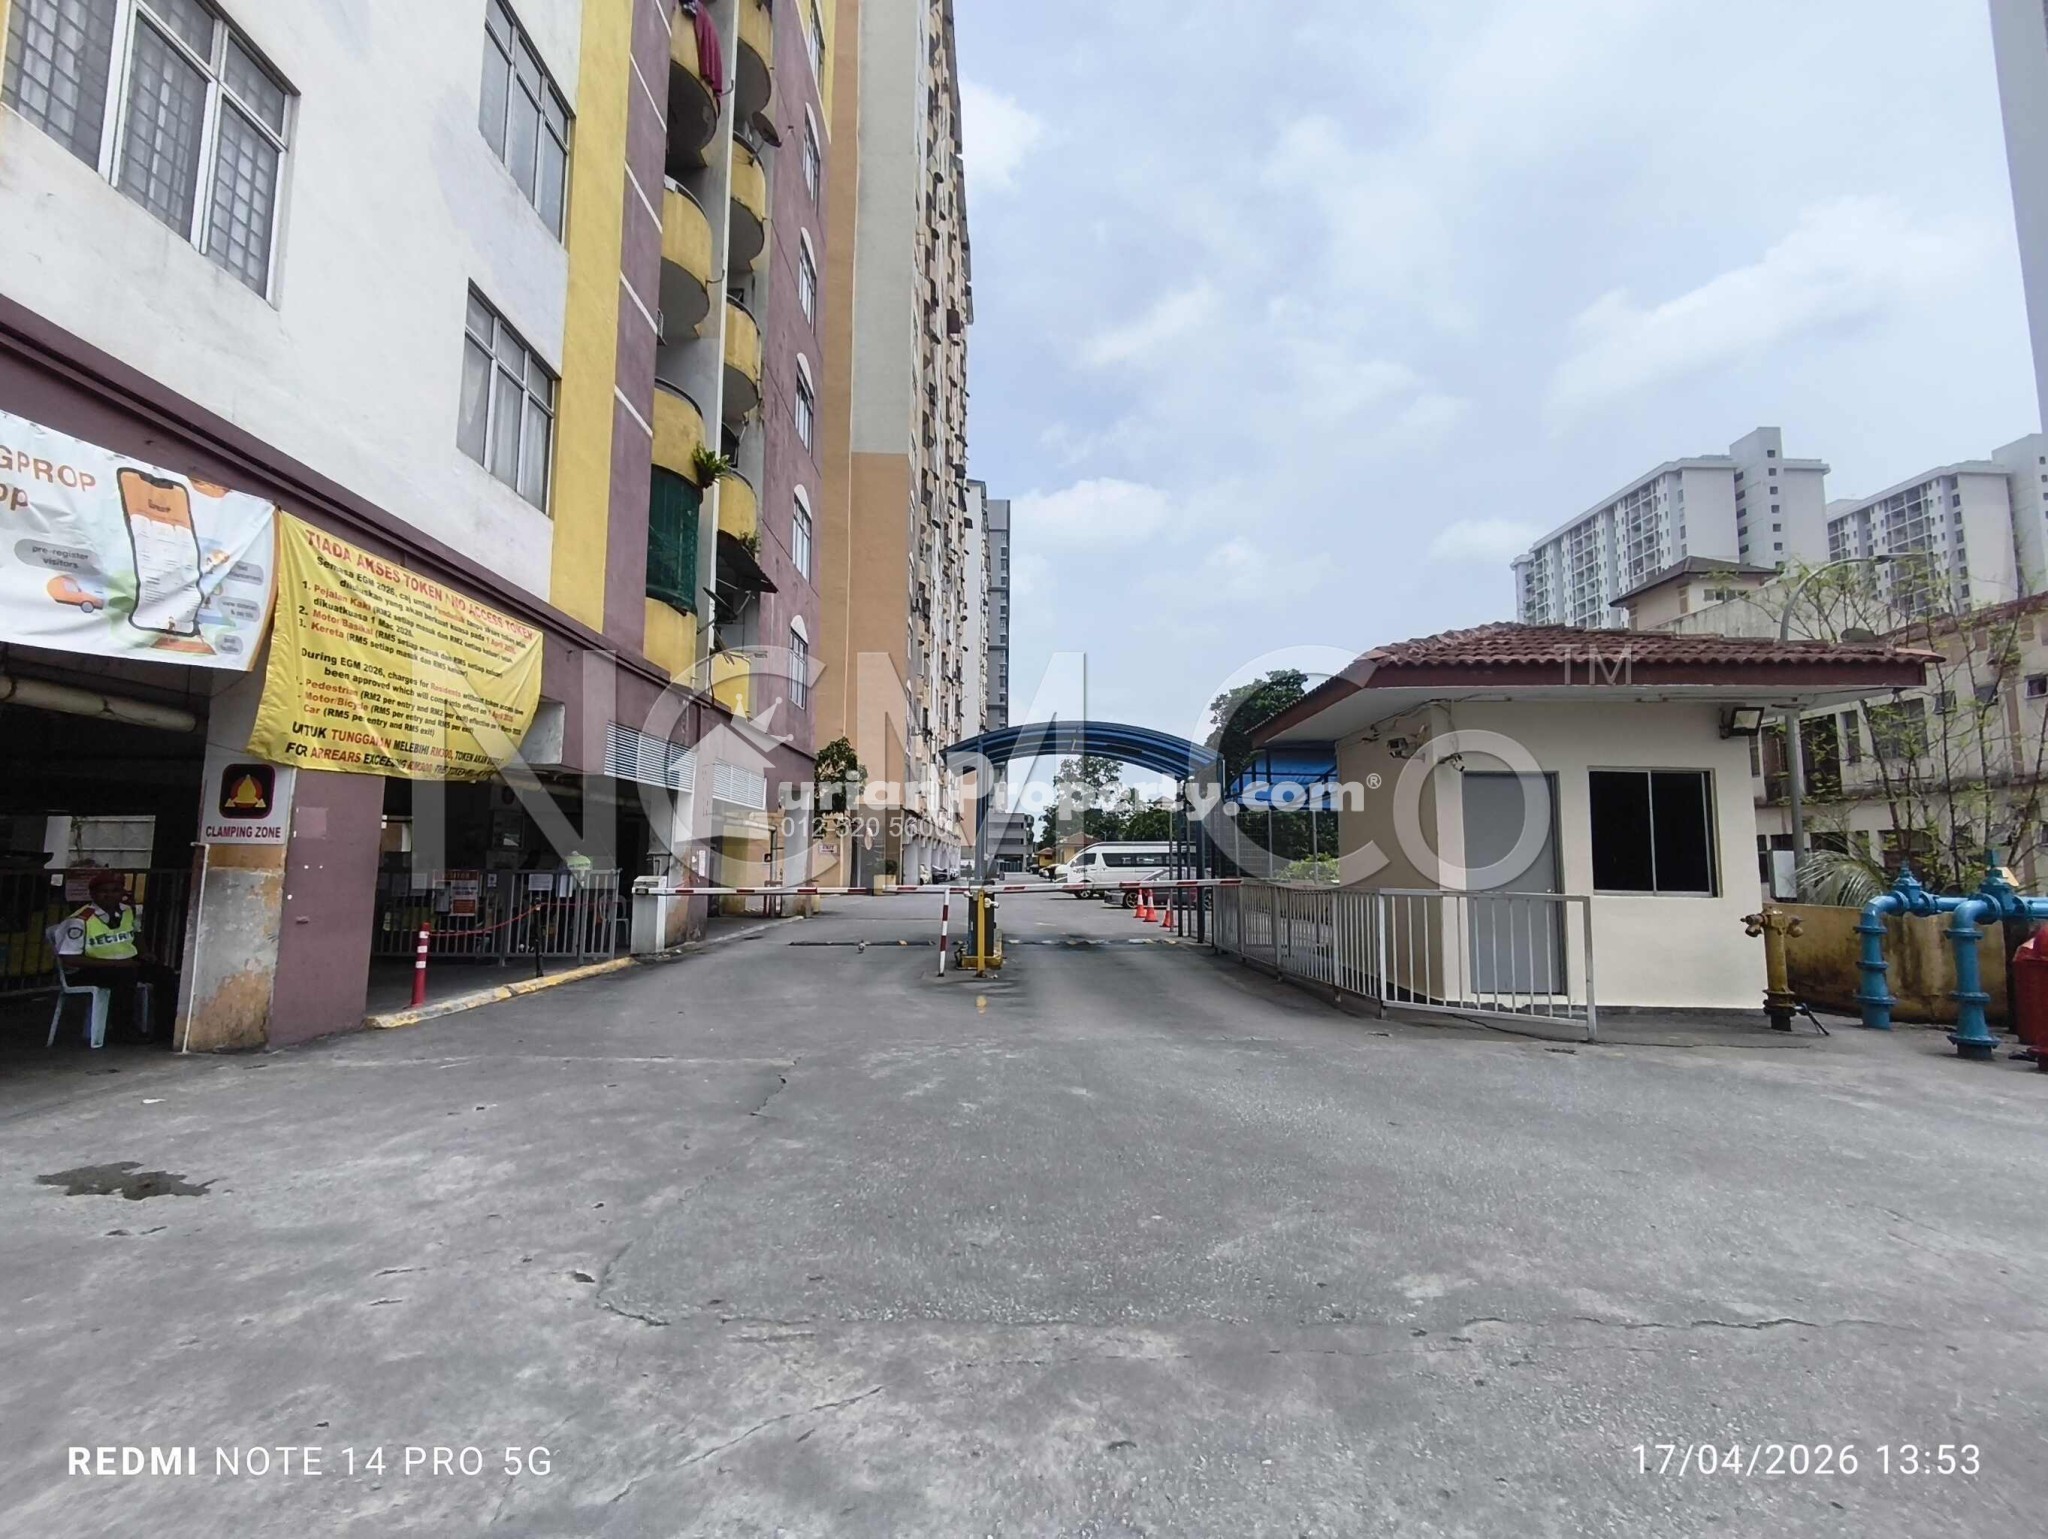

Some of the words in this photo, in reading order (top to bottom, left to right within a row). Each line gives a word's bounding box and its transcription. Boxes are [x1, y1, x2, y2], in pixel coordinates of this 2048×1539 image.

[42, 557, 79, 570] visitors
[301, 580, 311, 591] 1.
[314, 584, 348, 603] Pejalan
[350, 597, 371, 612] Kaki
[305, 529, 352, 562] TIADA
[356, 554, 401, 583] AKSES
[403, 573, 443, 602] TOKEN
[451, 598, 466, 611] NO
[469, 604, 503, 628] ACCESS
[505, 619, 533, 641] TOKEN
[356, 574, 375, 586] EGM
[413, 598, 432, 611] untuk
[298, 605, 309, 616] 2.
[375, 629, 396, 643] (RM5
[313, 597, 368, 623] dikuatkuasa
[371, 615, 375, 624] 1
[378, 618, 394, 630] Mac
[298, 618, 307, 629] 3.
[310, 621, 344, 639] Kereta
[346, 631, 369, 646] (RM5
[370, 640, 395, 656] setiap
[301, 647, 338, 666] During
[340, 656, 361, 670] EGM
[363, 662, 386, 679] 2026,
[387, 670, 418, 686] charges
[419, 678, 429, 689] for
[324, 666, 350, 680] been
[352, 674, 391, 691] approved
[392, 683, 415, 697] which
[416, 690, 429, 700] will
[360, 689, 381, 703] (RM2
[382, 695, 396, 706] per
[397, 699, 415, 712] entry
[416, 705, 429, 714] and
[429, 708, 443, 717] RM2
[370, 704, 391, 717] (RM5
[392, 709, 404, 720] per
[405, 714, 423, 725] entry
[424, 718, 436, 727] and
[303, 703, 321, 715] Car
[322, 707, 349, 720] (RM5
[366, 716, 388, 729] entry
[389, 721, 402, 731] and
[403, 723, 419, 734] RM5
[420, 727, 435, 738] exit)
[285, 742, 308, 757] FOR
[310, 747, 362, 763] ARREARS
[393, 739, 430, 756] MELEBIHI
[430, 746, 454, 761] RM300,
[455, 751, 474, 762] TOKEN
[474, 754, 489, 764] AKAN
[205, 825, 253, 838] CLAMPING
[254, 826, 281, 839] ZONE
[89, 930, 135, 946] SECURIT
